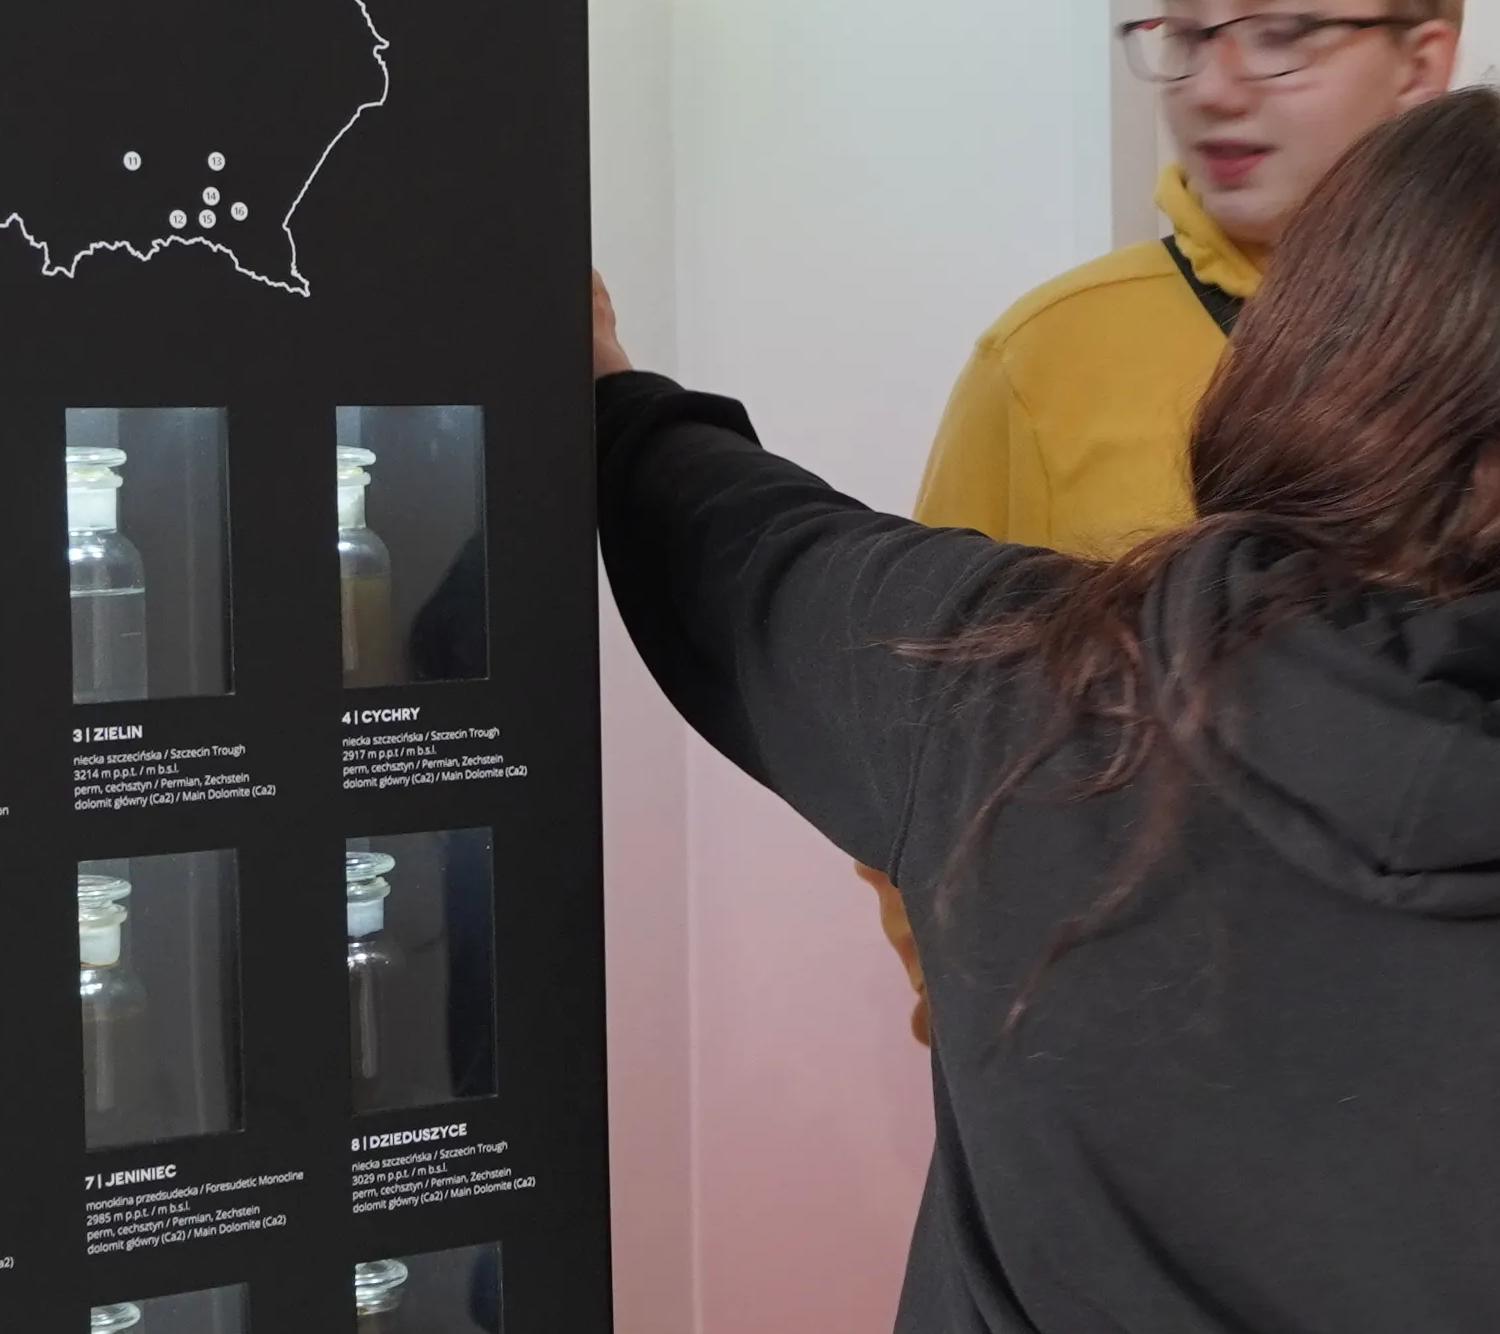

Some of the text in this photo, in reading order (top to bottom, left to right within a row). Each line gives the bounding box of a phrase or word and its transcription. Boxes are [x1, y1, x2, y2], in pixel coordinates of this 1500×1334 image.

[341, 706, 421, 724] 4 CYCHRY
[72, 725, 143, 743] 3 ZIELIN
[351, 1122, 468, 1152] 8 DZIEDUSZYCE
[84, 1163, 177, 1191] 7 JENINIEC
